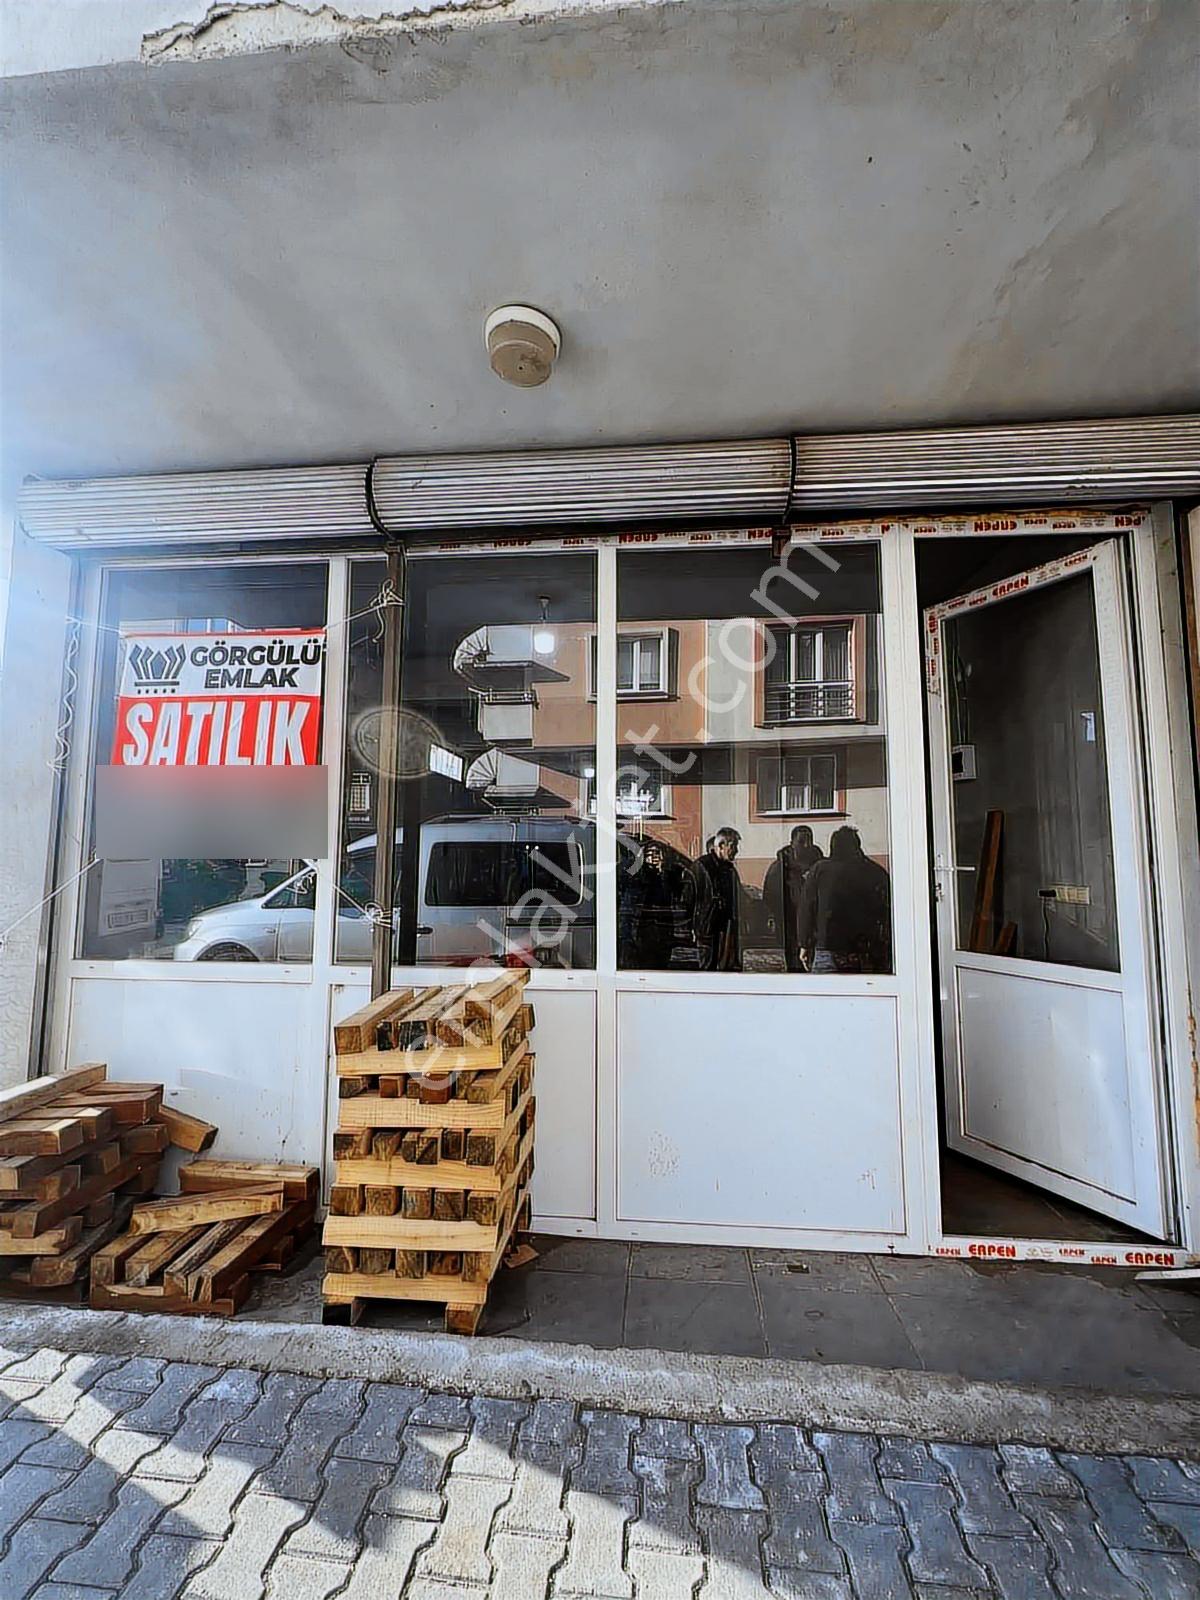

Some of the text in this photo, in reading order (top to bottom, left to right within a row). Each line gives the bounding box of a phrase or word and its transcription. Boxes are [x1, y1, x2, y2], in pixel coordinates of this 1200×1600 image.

[190, 639, 321, 667] GÖRGÜLÜ
[204, 667, 300, 689] EMLAK
[122, 701, 311, 766] SATILIK
